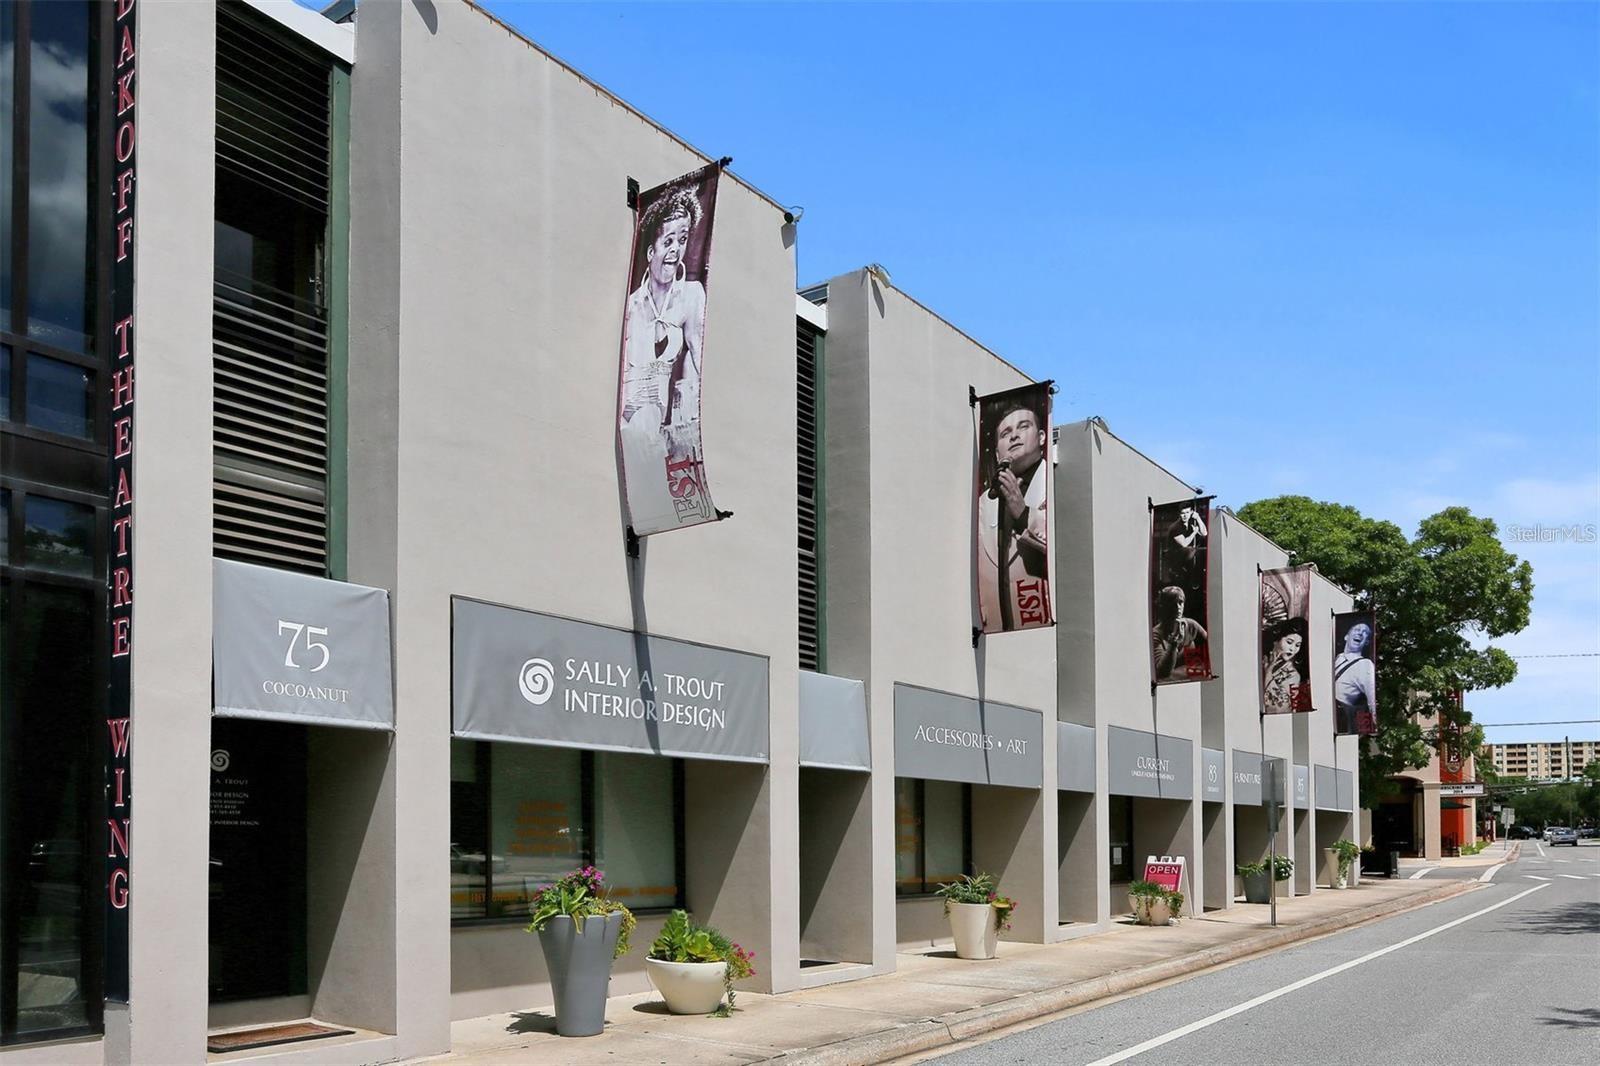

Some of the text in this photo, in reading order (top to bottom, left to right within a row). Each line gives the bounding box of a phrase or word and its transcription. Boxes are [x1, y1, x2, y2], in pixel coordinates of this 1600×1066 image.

[112, 314, 135, 658] THEATRE
[278, 619, 330, 672] 75
[262, 680, 349, 703] COCOANUT
[565, 658, 725, 701] SALLY A. TROUT
[564, 689, 725, 732] INTERIOR DESIGN
[914, 725, 1028, 755] ACCESSORIES ART
[107, 717, 131, 909] WING
[1148, 865, 1179, 874] OPEN
